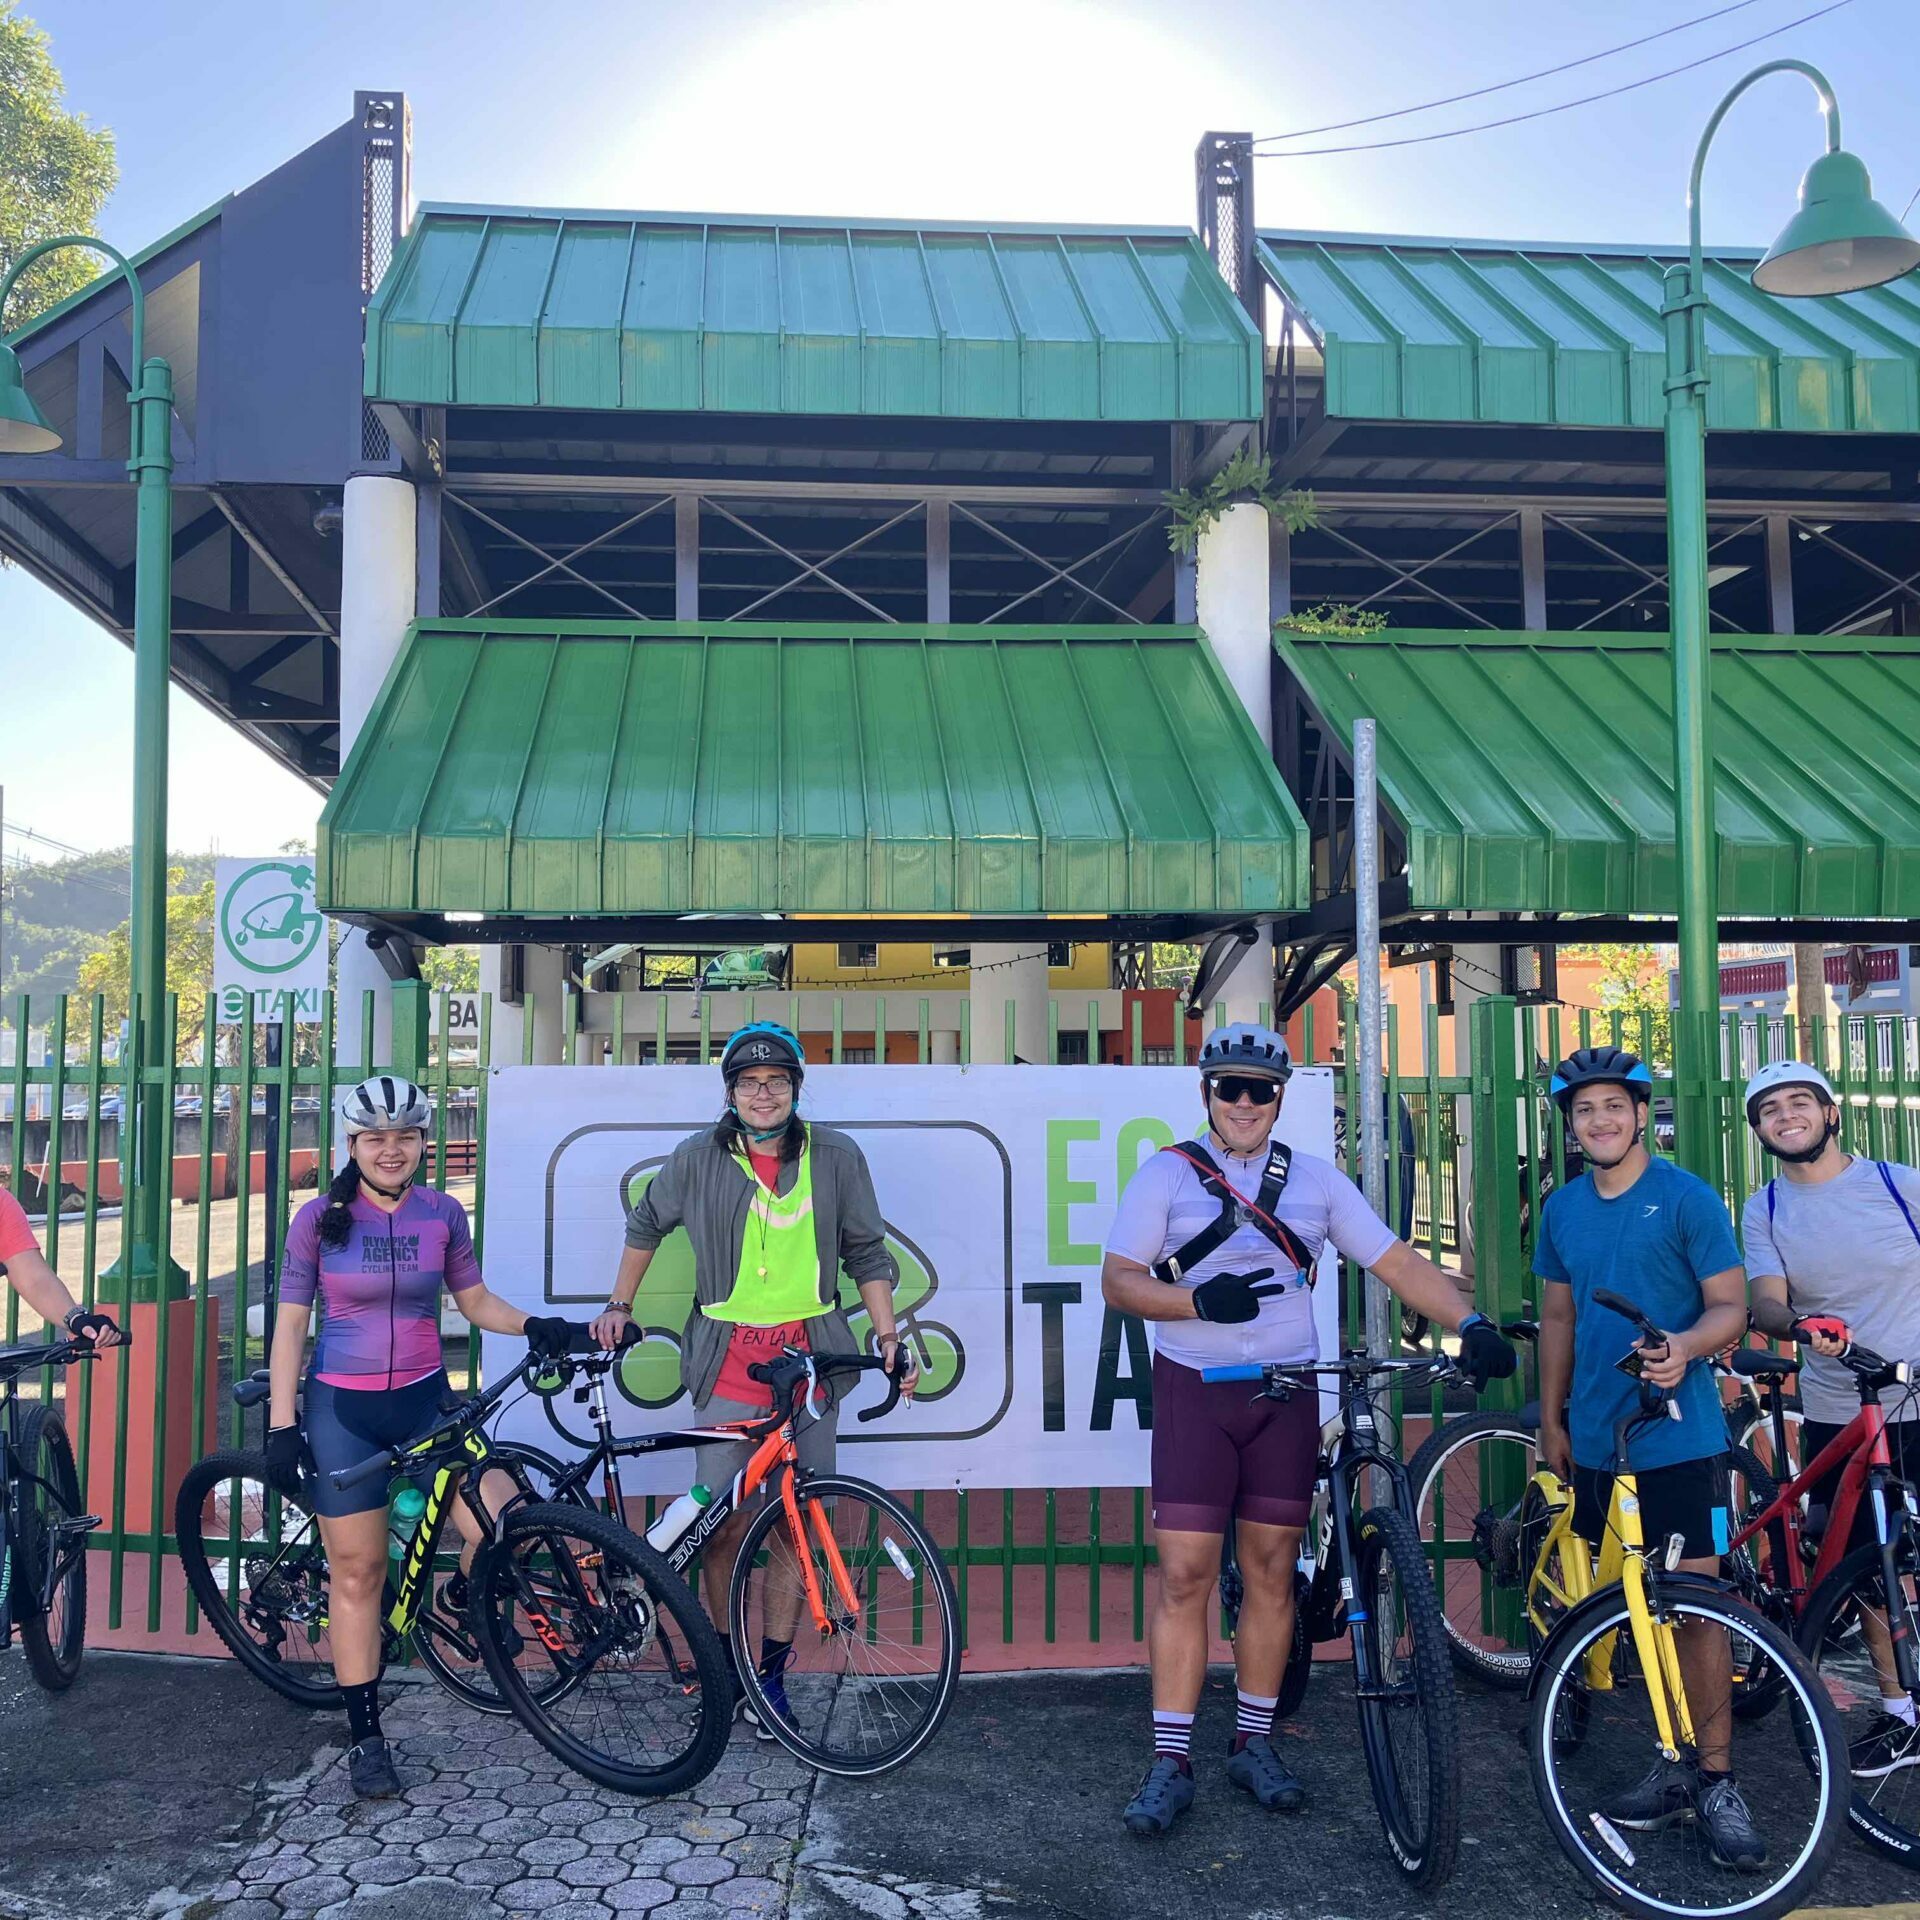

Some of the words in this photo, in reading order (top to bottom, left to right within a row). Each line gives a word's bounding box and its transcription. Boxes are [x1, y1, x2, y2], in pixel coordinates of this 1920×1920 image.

[255, 988, 318, 1013] TAXI
[362, 1235, 408, 1248] OLYMPIC
[362, 1247, 419, 1263] AGENCY
[397, 1263, 419, 1273] TEAM
[743, 1329, 764, 1345] EN
[769, 1328, 786, 1346] LA
[667, 1496, 729, 1572] GMC
[1482, 1650, 1531, 1668] american
